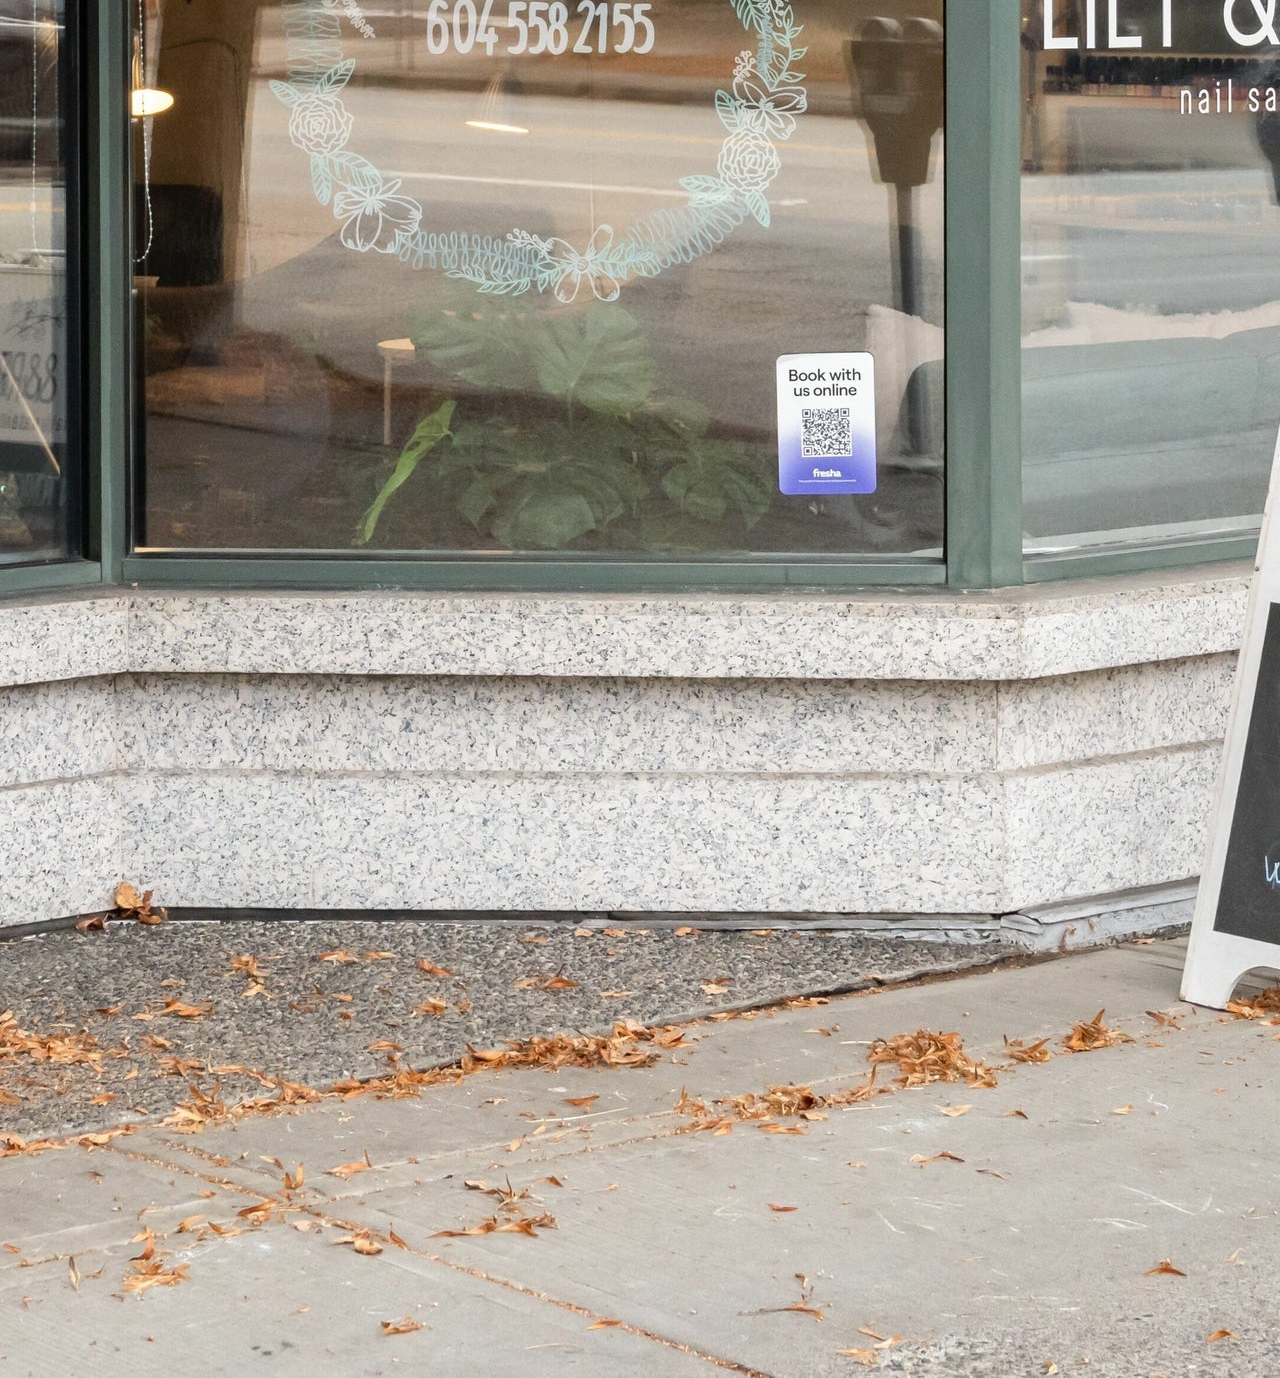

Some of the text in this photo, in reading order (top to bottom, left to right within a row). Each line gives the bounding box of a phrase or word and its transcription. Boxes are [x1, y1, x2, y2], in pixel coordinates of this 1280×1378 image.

[507, 1, 568, 55] 558
[573, 0, 655, 54] 2155
[1180, 79, 1233, 115] nail
[789, 368, 862, 382] Book with
[794, 384, 858, 397] us online
[813, 468, 842, 478] fresha
